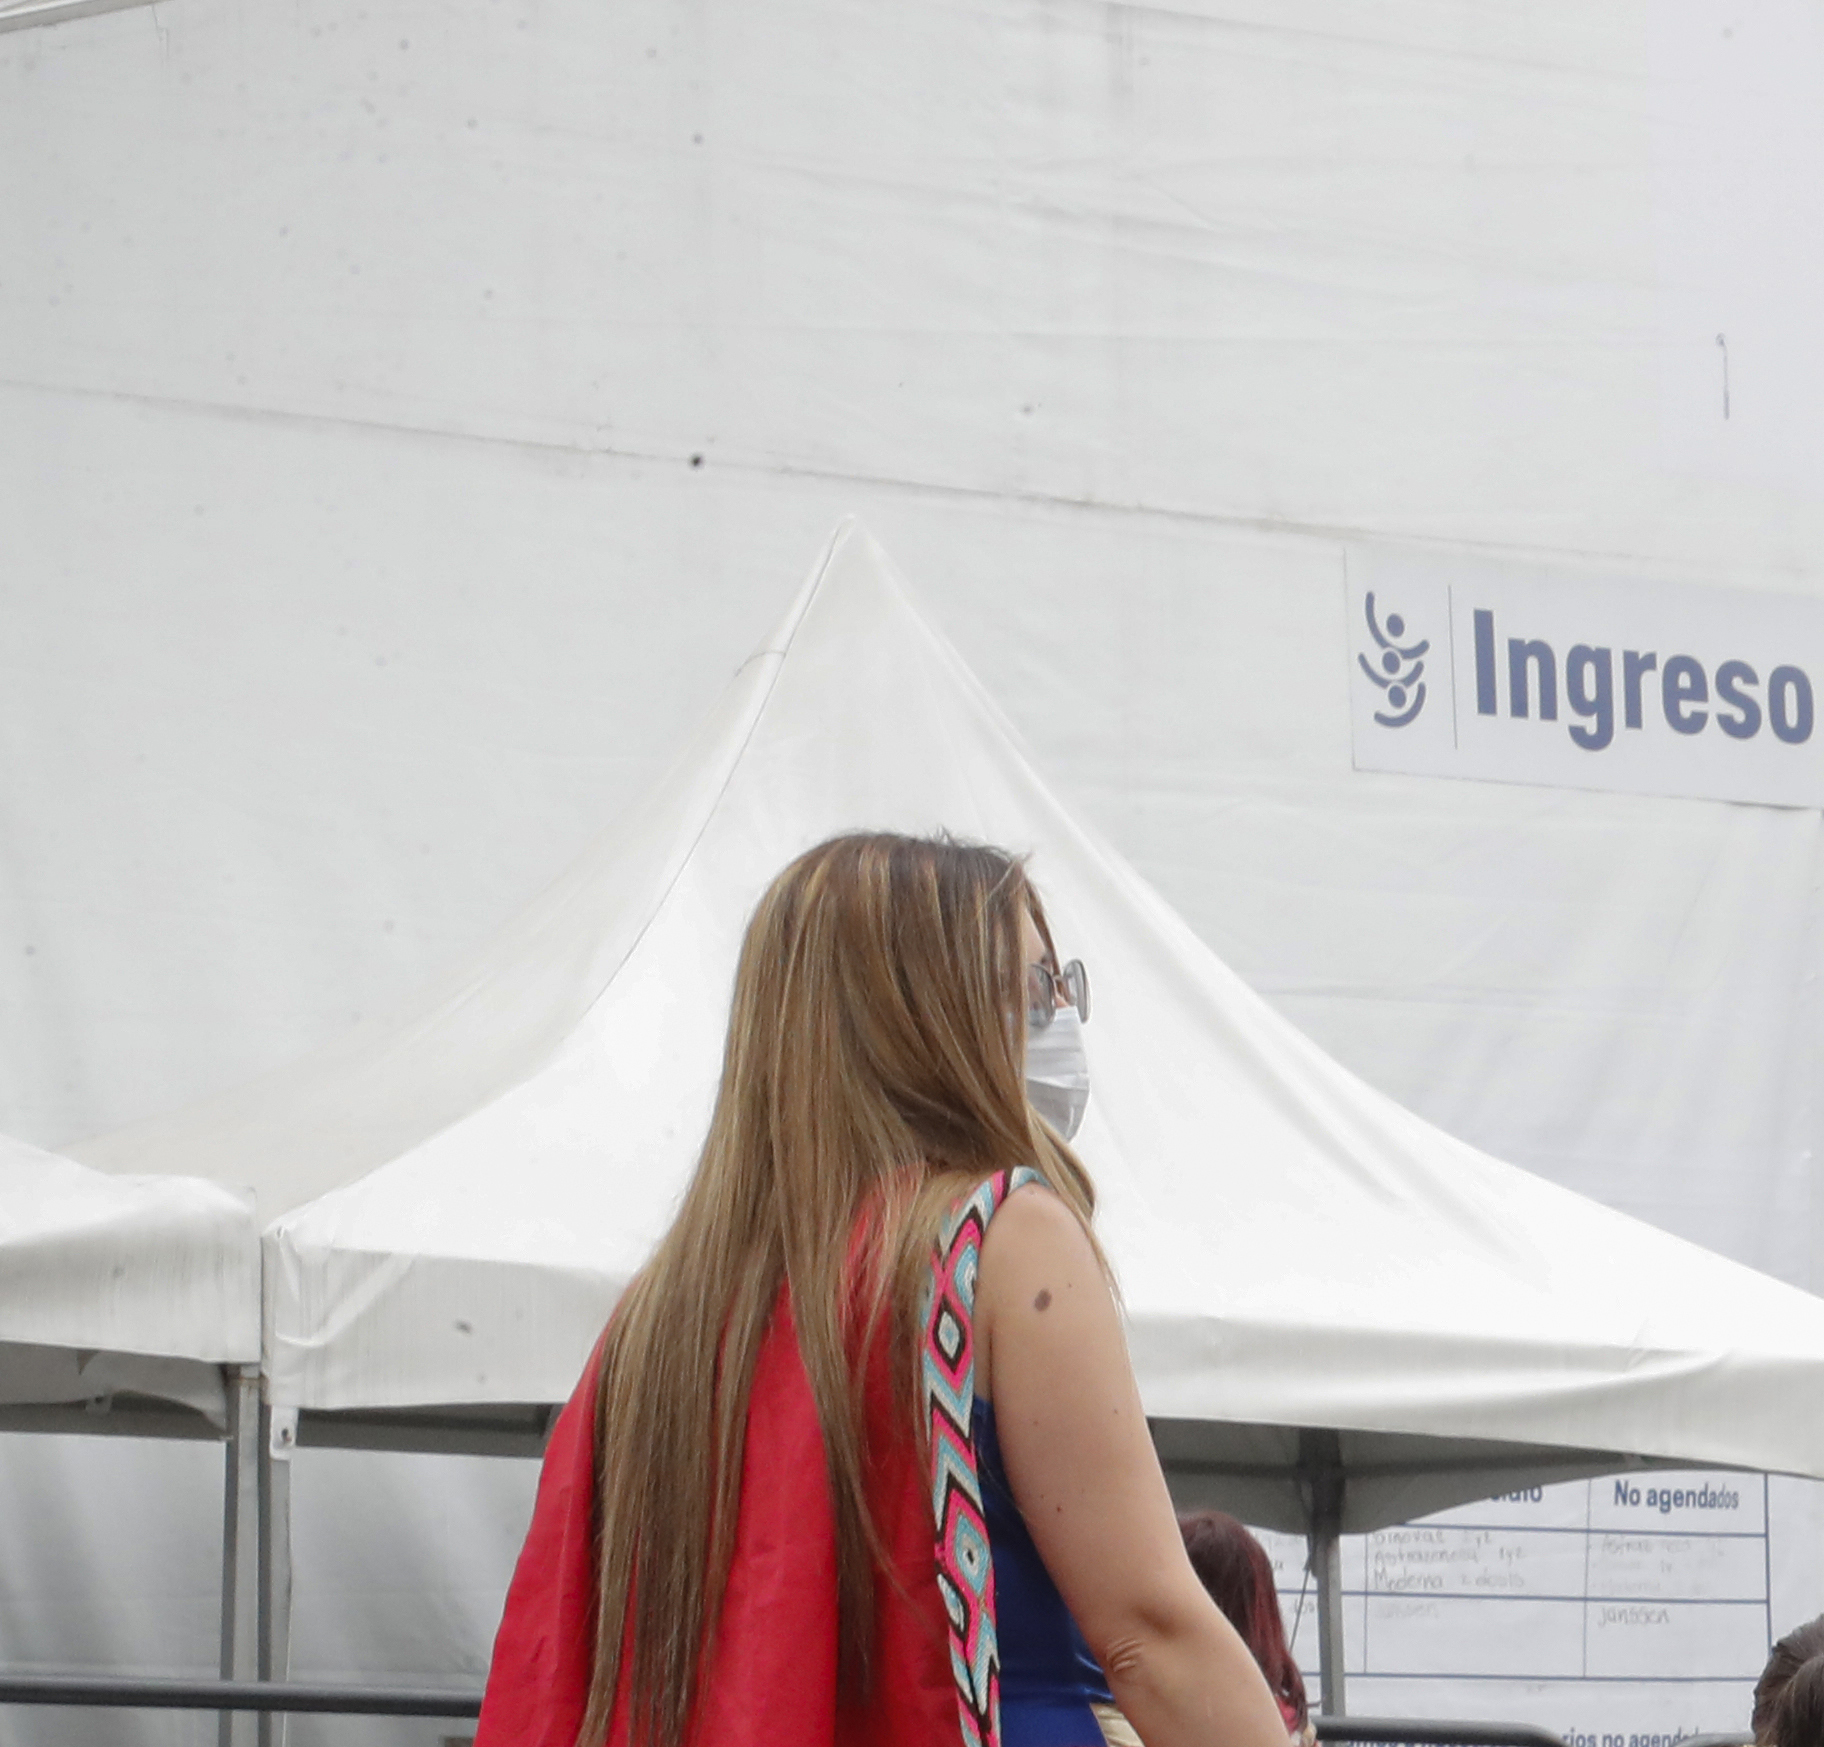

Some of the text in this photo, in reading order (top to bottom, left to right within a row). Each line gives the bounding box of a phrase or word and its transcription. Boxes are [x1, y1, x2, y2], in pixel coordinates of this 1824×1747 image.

[1472, 608, 1815, 752] Ingreso
[1613, 1479, 1740, 1514] No agendados
